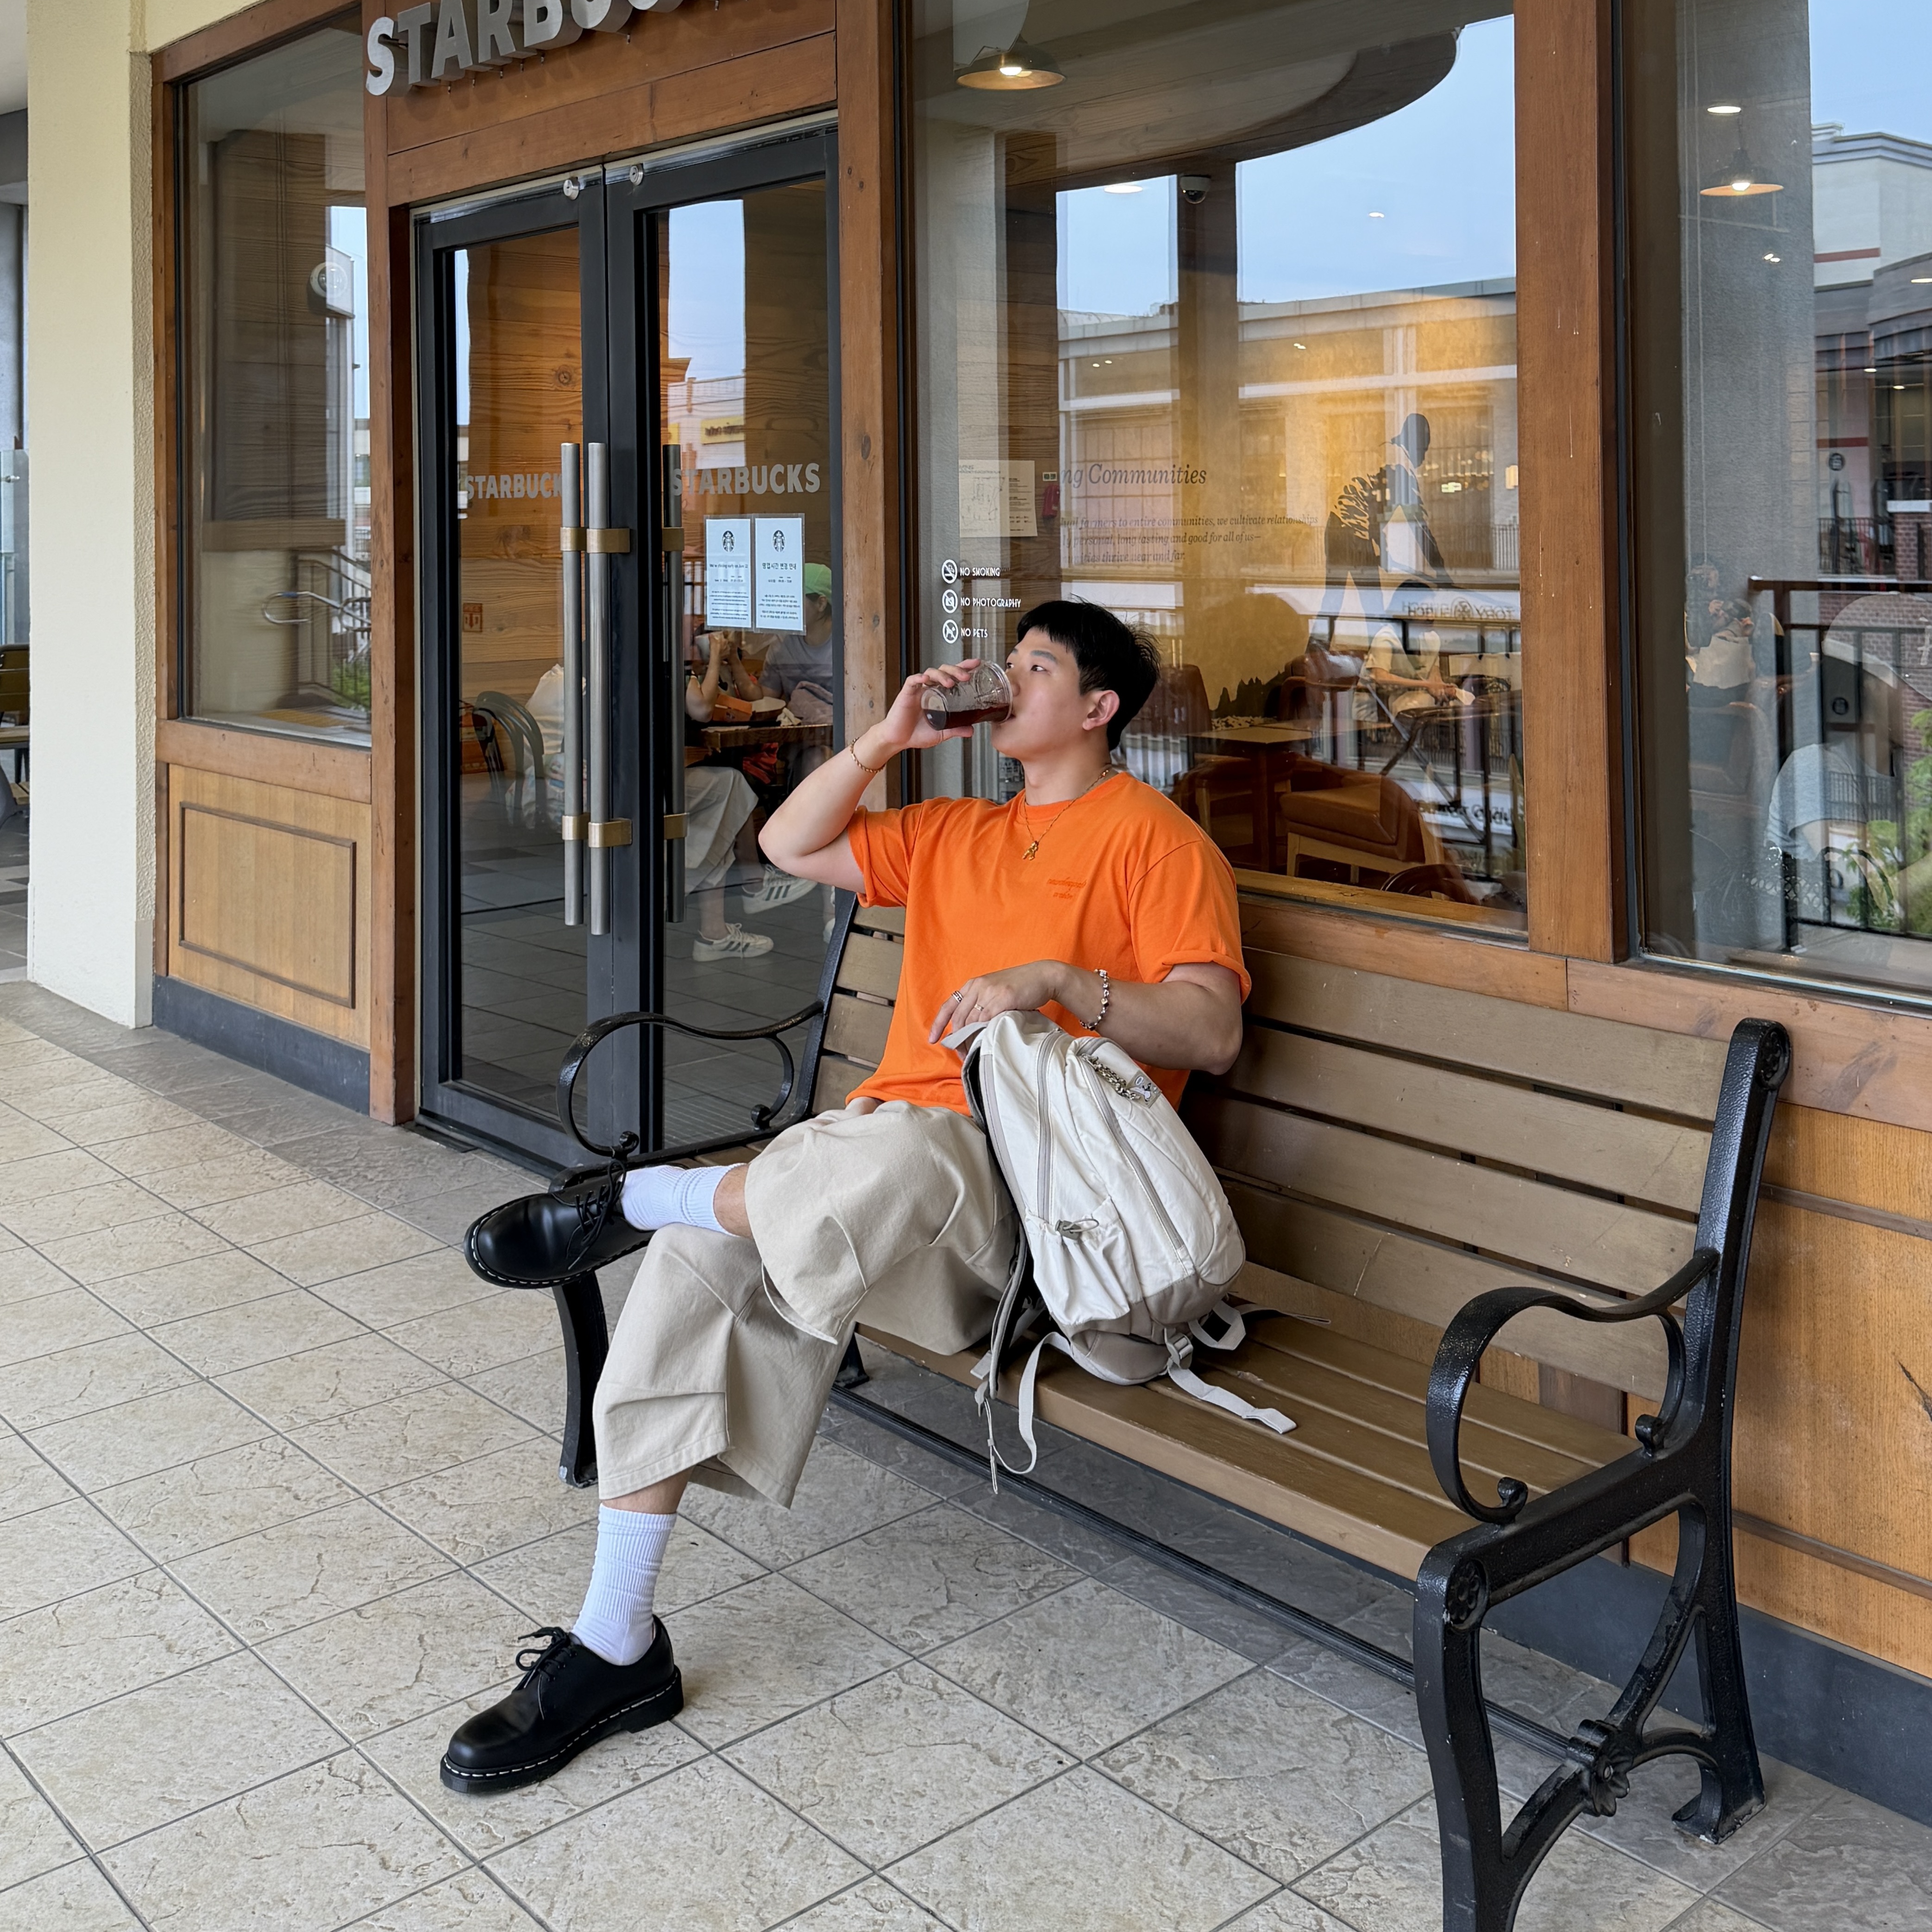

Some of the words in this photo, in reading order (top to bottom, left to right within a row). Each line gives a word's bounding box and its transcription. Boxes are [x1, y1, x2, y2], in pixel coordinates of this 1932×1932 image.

[366, 0, 662, 95] STARB
[673, 463, 821, 496] STARBUCKS
[1088, 463, 1207, 484] Communities
[1079, 517, 1117, 530] farmers
[1118, 517, 1127, 527] to
[1129, 516, 1156, 527] entire
[1217, 517, 1228, 525] we
[1229, 514, 1265, 525] cultivate
[1267, 514, 1318, 527] relationships
[1117, 534, 1136, 546] long
[1172, 532, 1187, 543] and
[1188, 531, 1208, 545] good
[1208, 532, 1222, 544] for
[1223, 531, 1234, 542] all
[1236, 531, 1246, 544] of
[960, 567, 970, 576] NO
[972, 567, 1000, 577] SMOKING
[960, 597, 971, 606] NO
[972, 597, 1021, 608] PHOTOGRAPHY
[961, 627, 971, 637] NO
[973, 628, 988, 638] PETS
